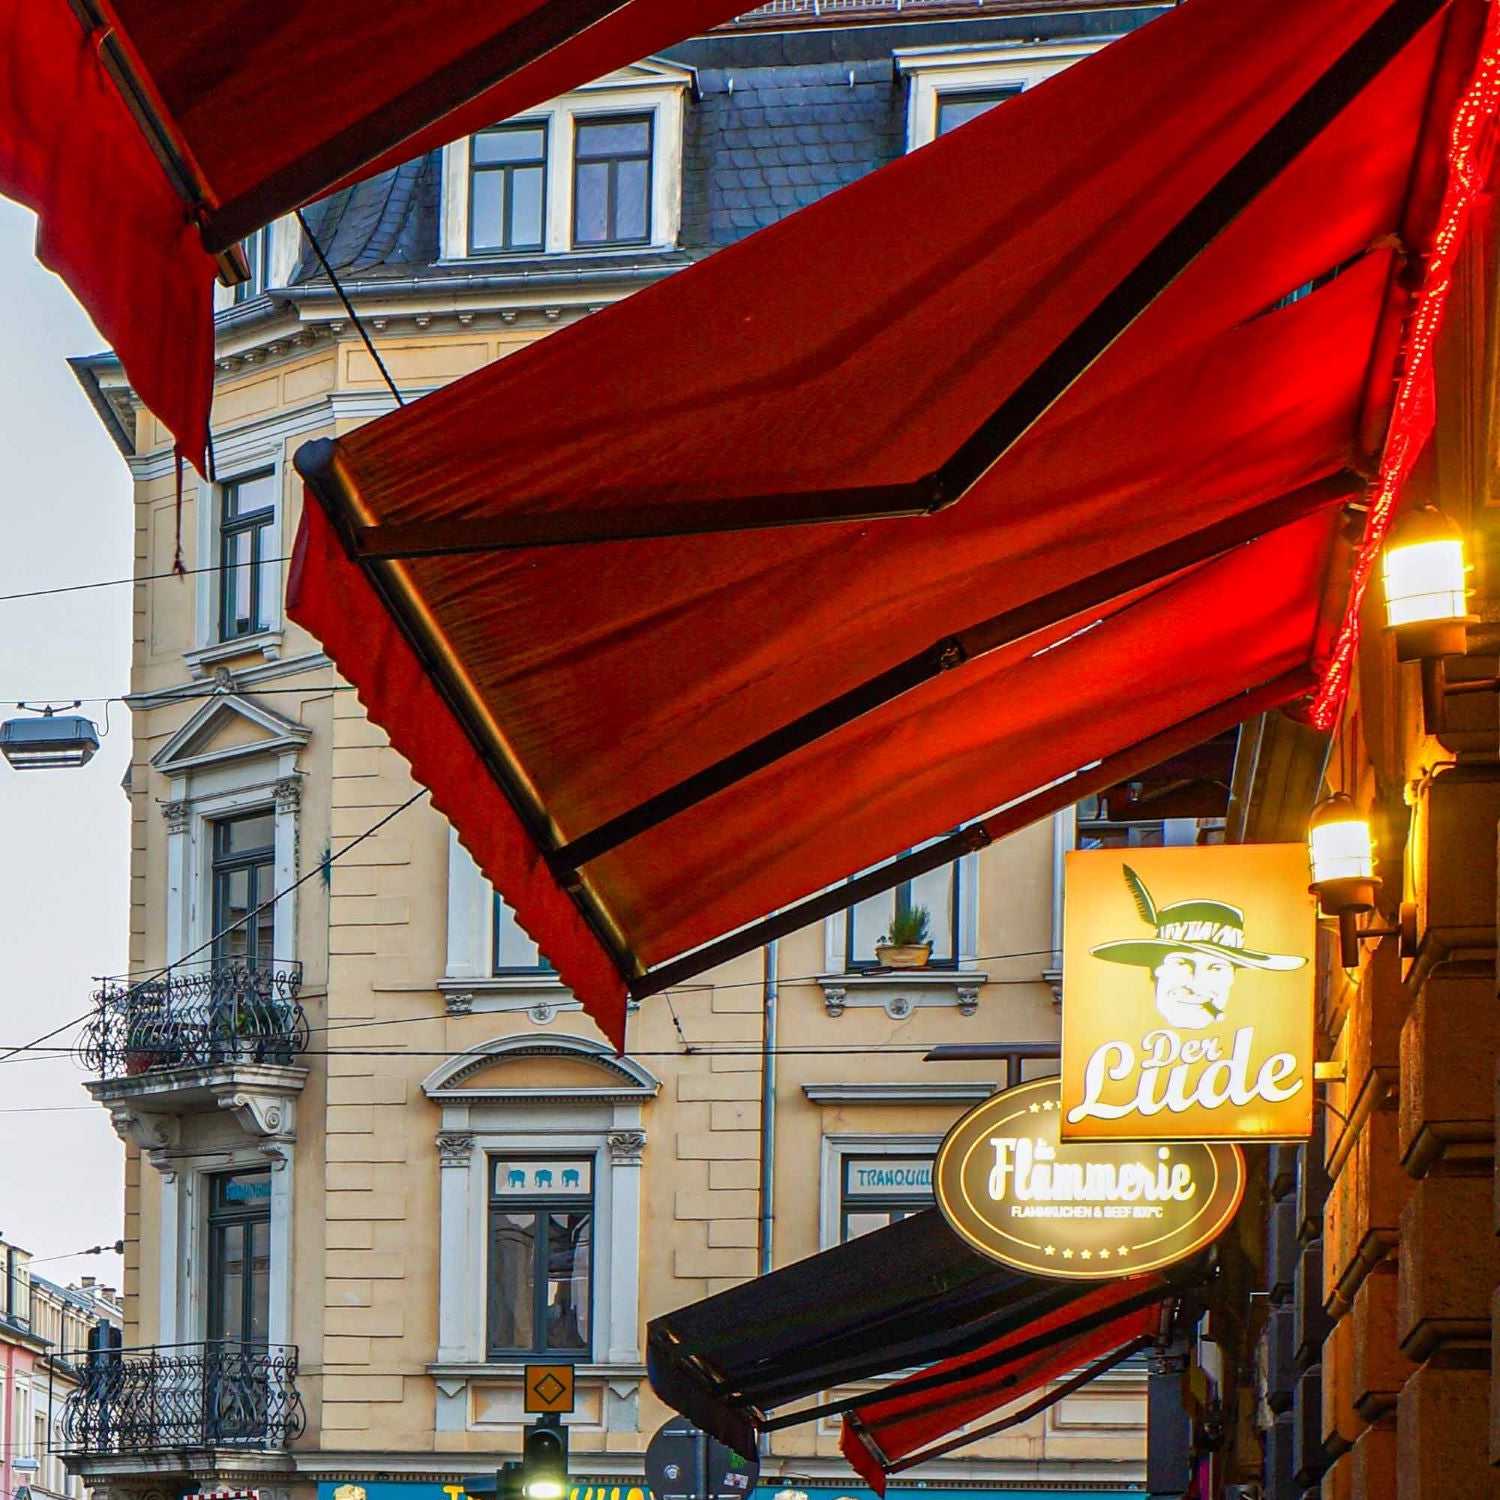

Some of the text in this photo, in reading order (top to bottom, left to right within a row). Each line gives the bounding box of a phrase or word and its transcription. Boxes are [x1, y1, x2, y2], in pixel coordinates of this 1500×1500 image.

[1142, 1028, 1222, 1069] Der
[1068, 1027, 1303, 1124] Lude
[857, 1168, 932, 1187] TRANQUILL
